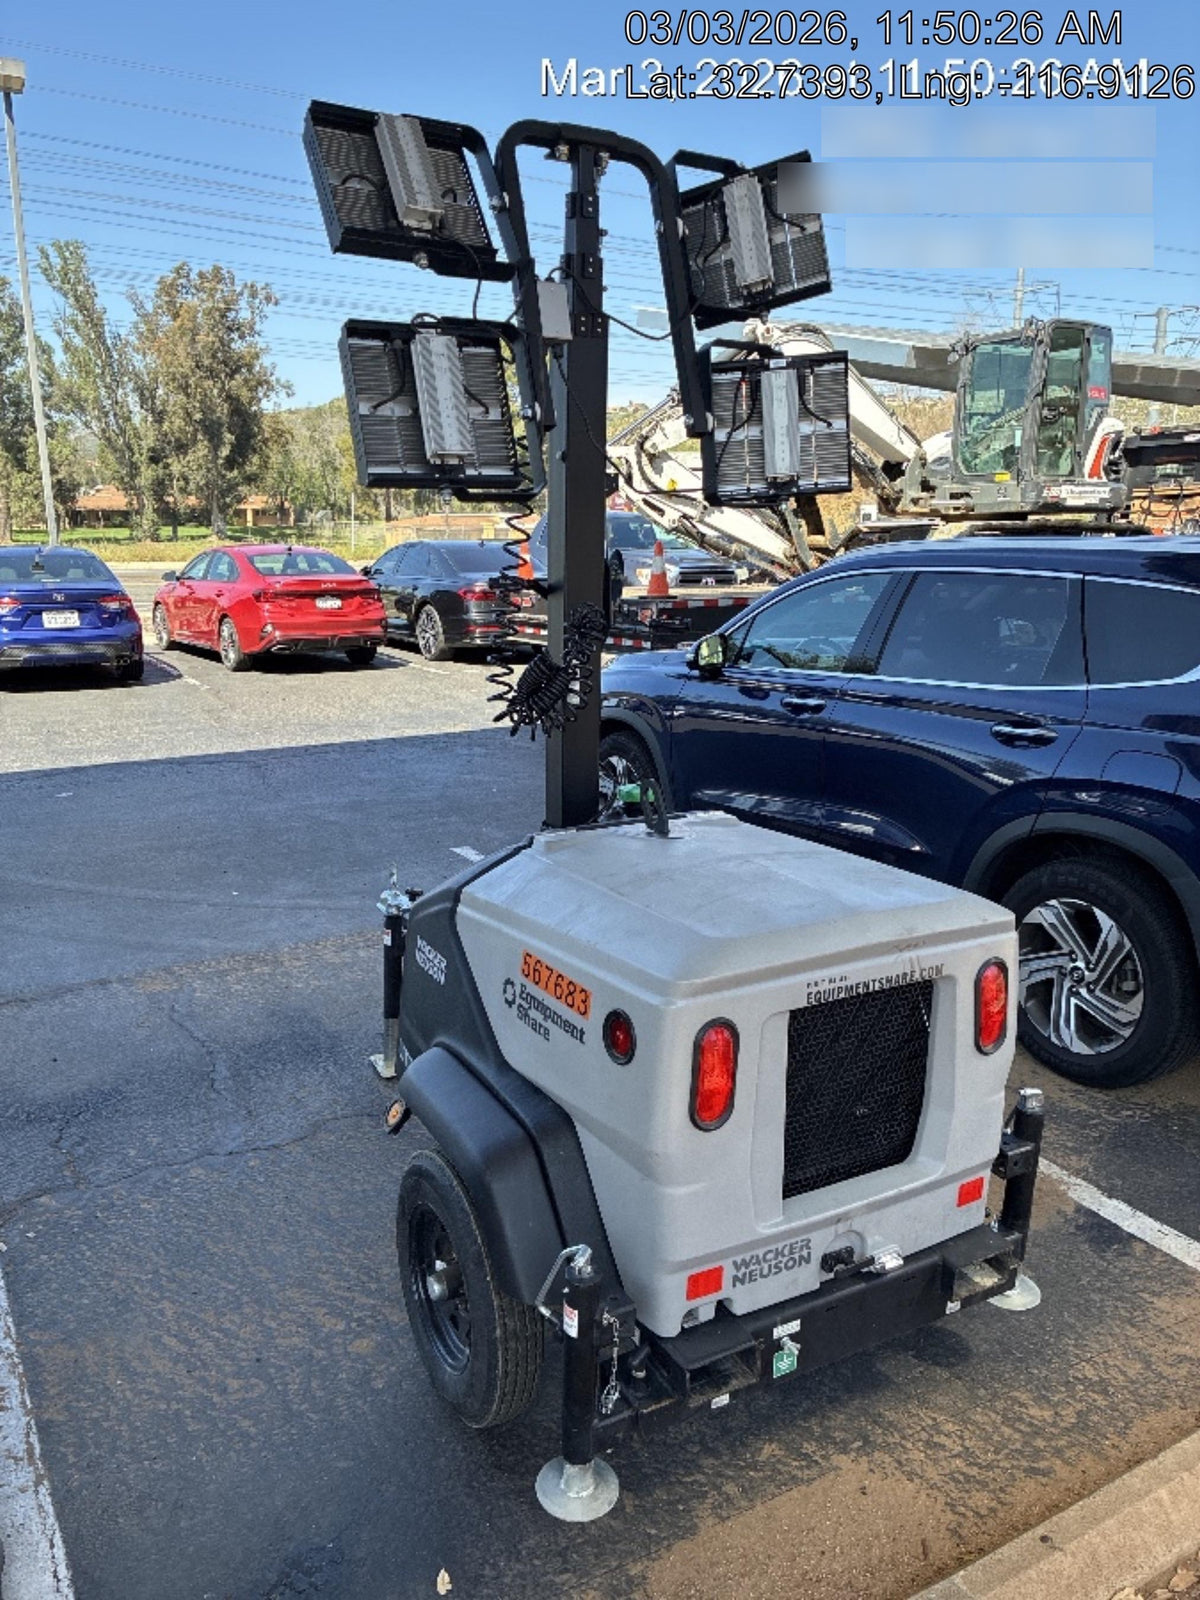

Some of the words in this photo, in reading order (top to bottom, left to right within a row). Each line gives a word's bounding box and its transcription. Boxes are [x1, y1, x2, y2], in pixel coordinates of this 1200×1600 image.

[521, 951, 590, 1016] 567683
[806, 963, 945, 1005] EQUIPMENTSHARE.COM
[516, 1003, 550, 1042] Share
[519, 983, 586, 1044] Equipment
[731, 1251, 812, 1289] NEUSON
[732, 1238, 811, 1273] WACKER
